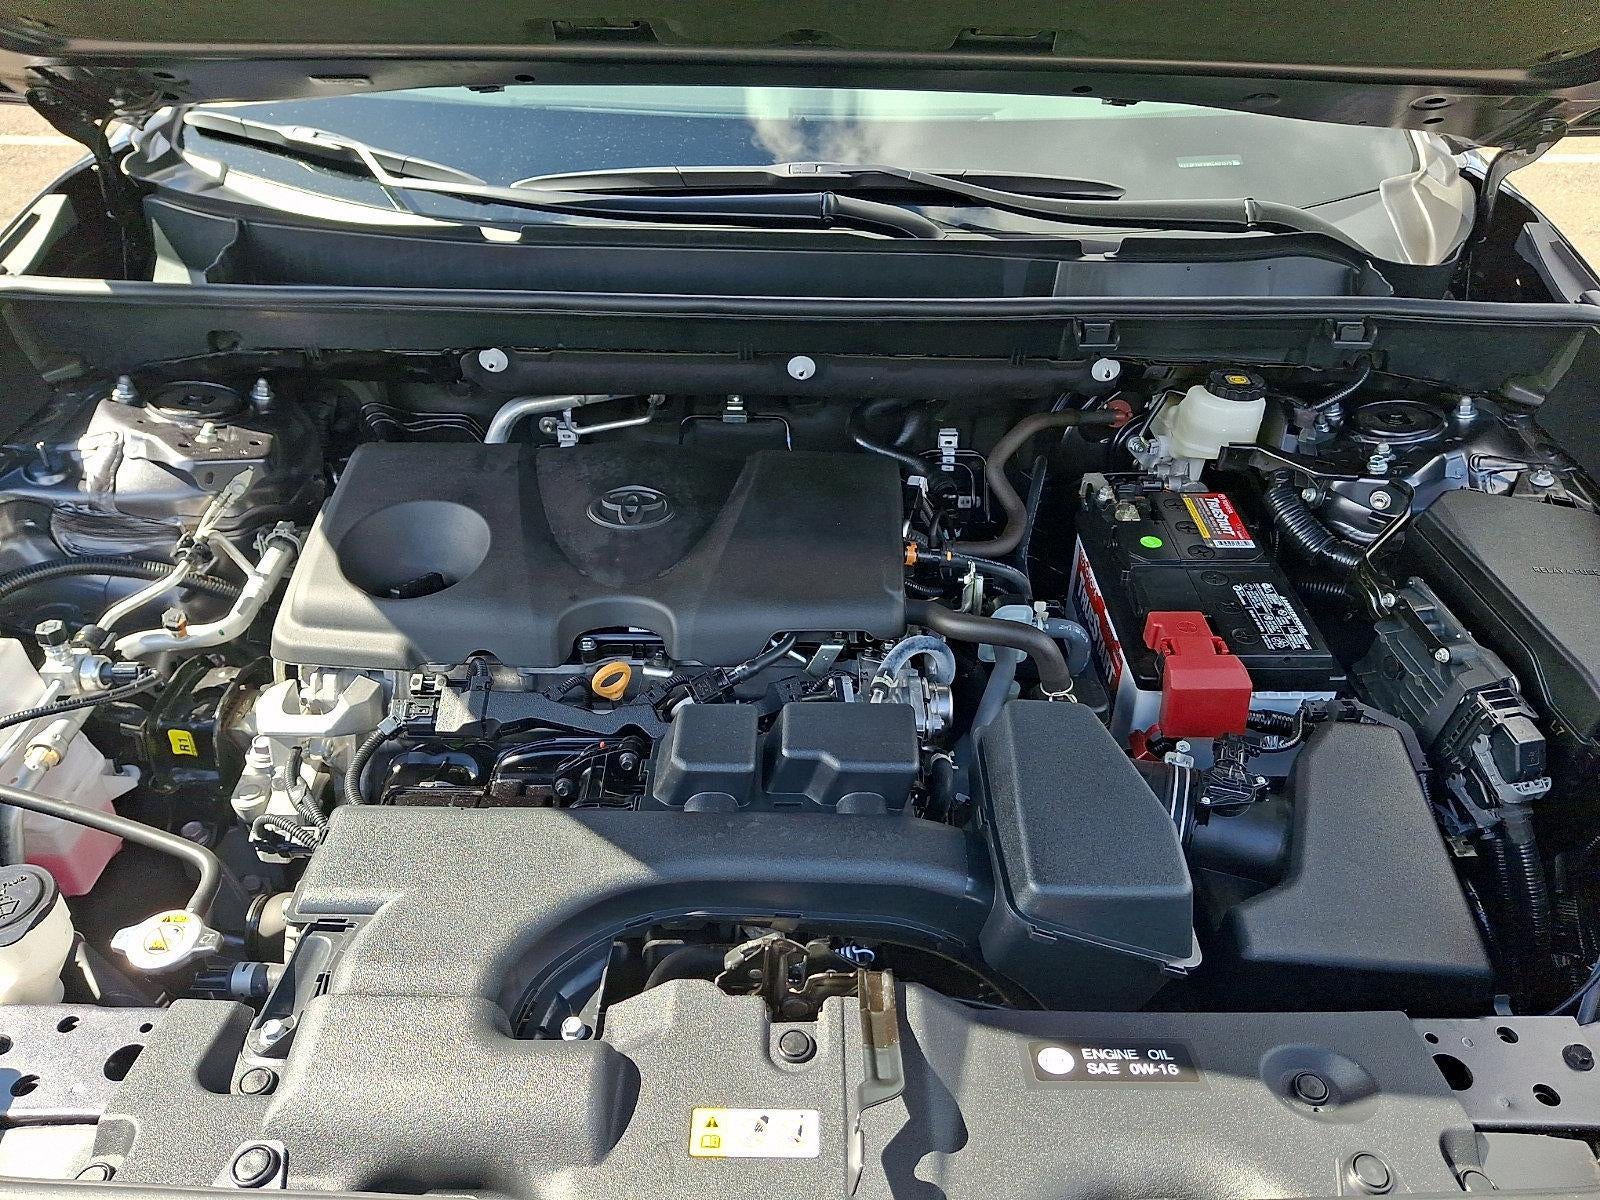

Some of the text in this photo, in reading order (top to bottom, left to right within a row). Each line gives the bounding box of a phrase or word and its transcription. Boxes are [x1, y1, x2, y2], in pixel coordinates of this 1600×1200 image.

[1532, 566, 1563, 574] RELAY
[178, 738, 190, 751] R1
[1081, 1048, 1175, 1061] ENGINE OIL
[1086, 1063, 1180, 1076] SAE 0W-16
